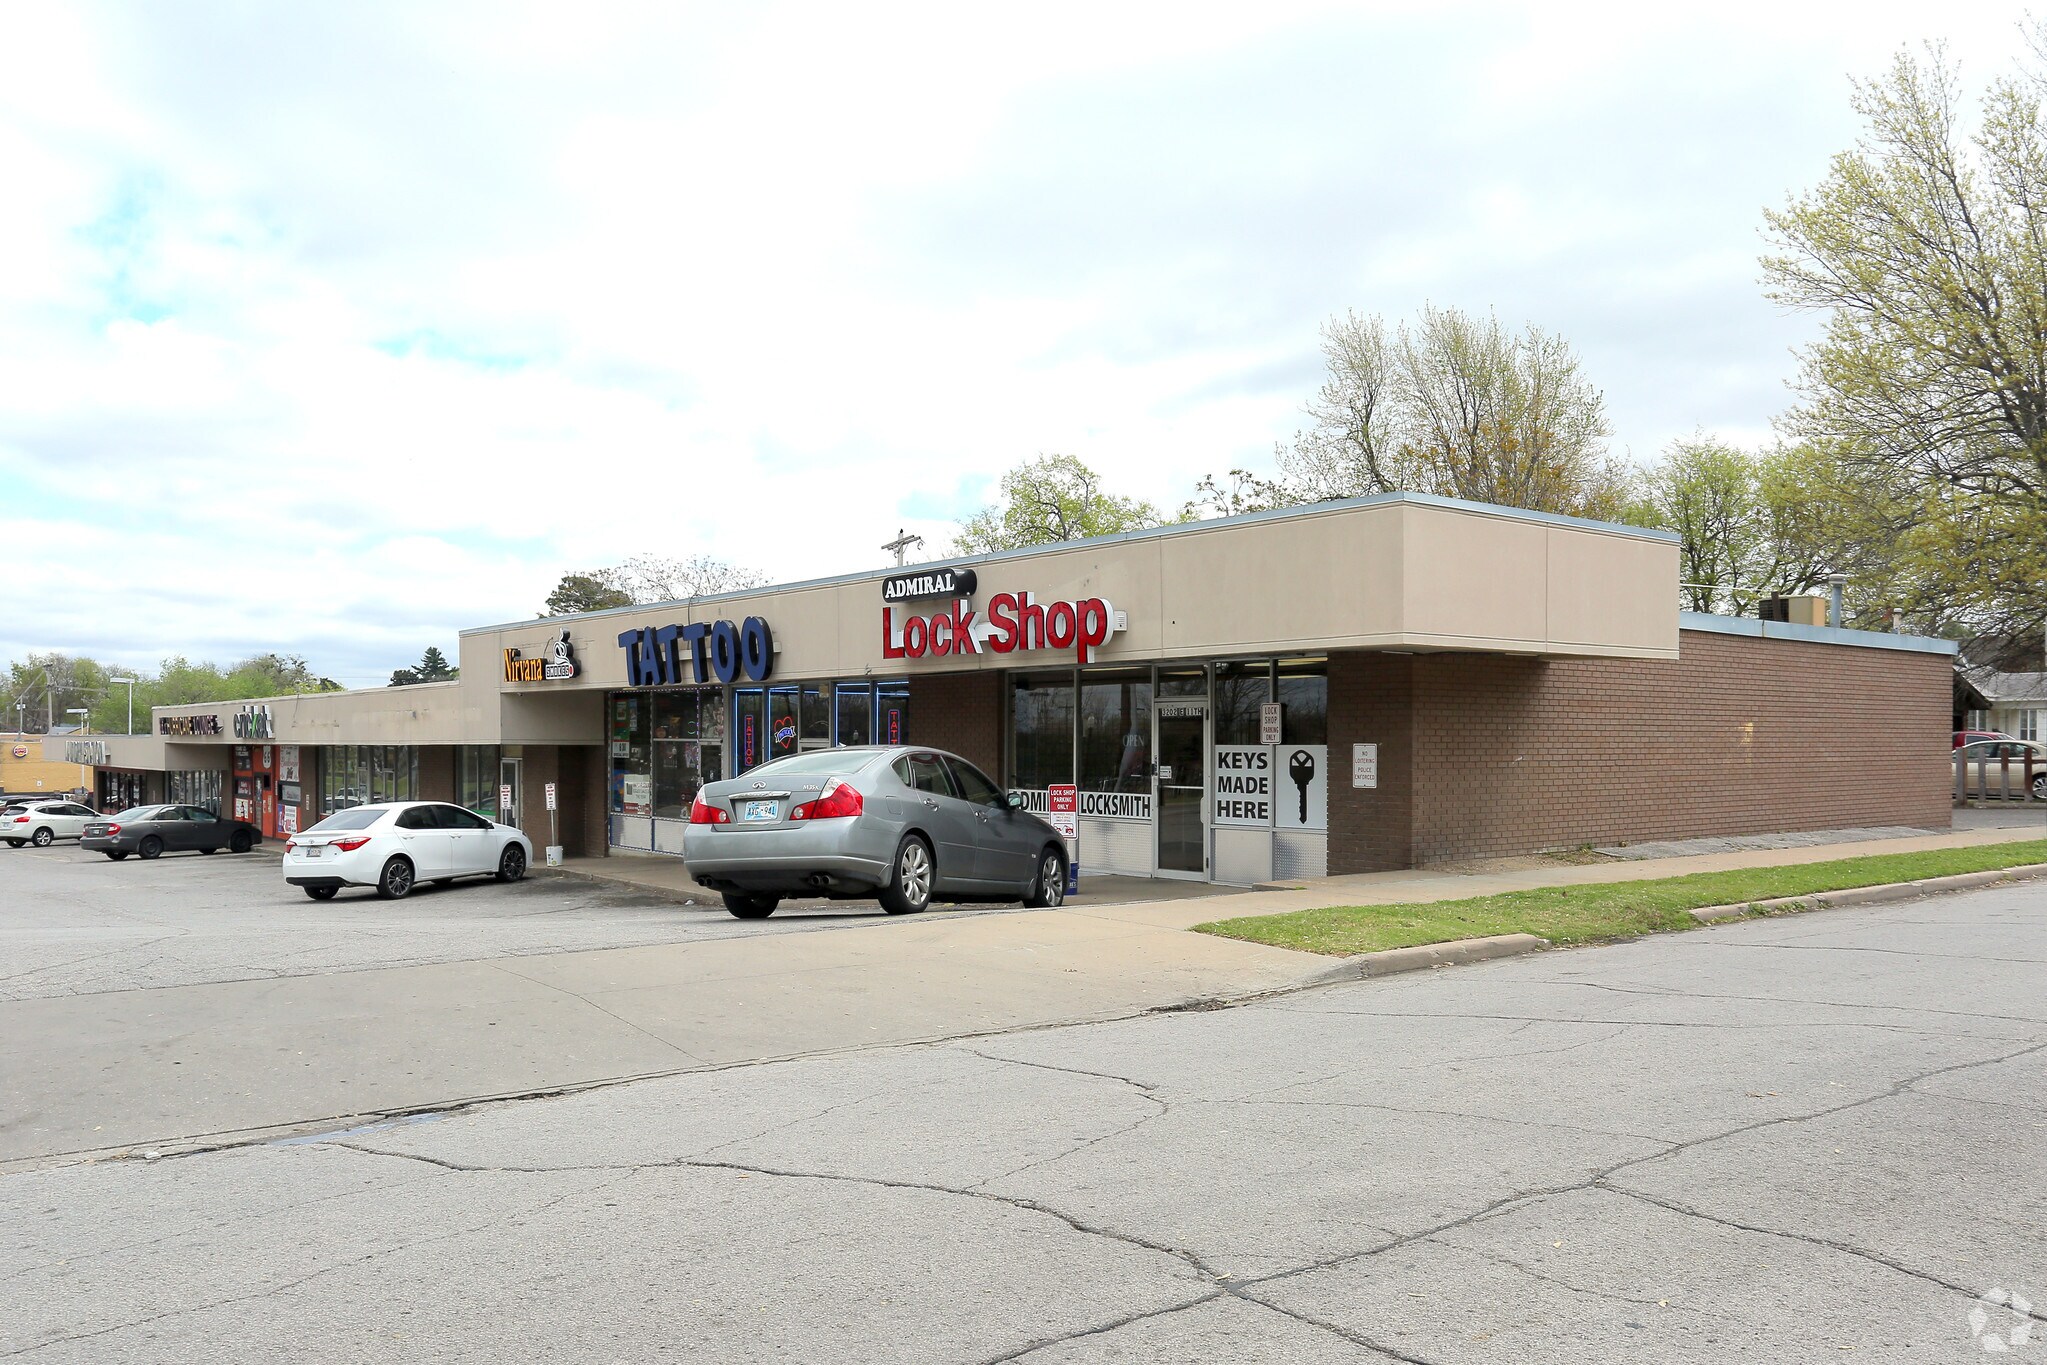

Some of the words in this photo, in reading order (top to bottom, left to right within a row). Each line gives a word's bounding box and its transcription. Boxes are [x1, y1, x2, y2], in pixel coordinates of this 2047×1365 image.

[885, 573, 955, 599] ADMIRAL
[883, 599, 983, 659] Lock
[988, 591, 1114, 664] Shop
[618, 616, 774, 687] TATTOO
[503, 648, 543, 682] Nirvana
[546, 665, 570, 678] SMOKES
[1264, 706, 1278, 715] LOCK
[1264, 716, 1278, 725] SHOP
[1263, 726, 1279, 734] PARKING
[1122, 734, 1145, 747] OPEN
[1218, 752, 1268, 769] KEYS
[1217, 776, 1268, 794] MADE
[1016, 791, 1049, 811] DMI
[1081, 794, 1151, 818] LOCKSMITH
[1217, 800, 1268, 819] HERE
